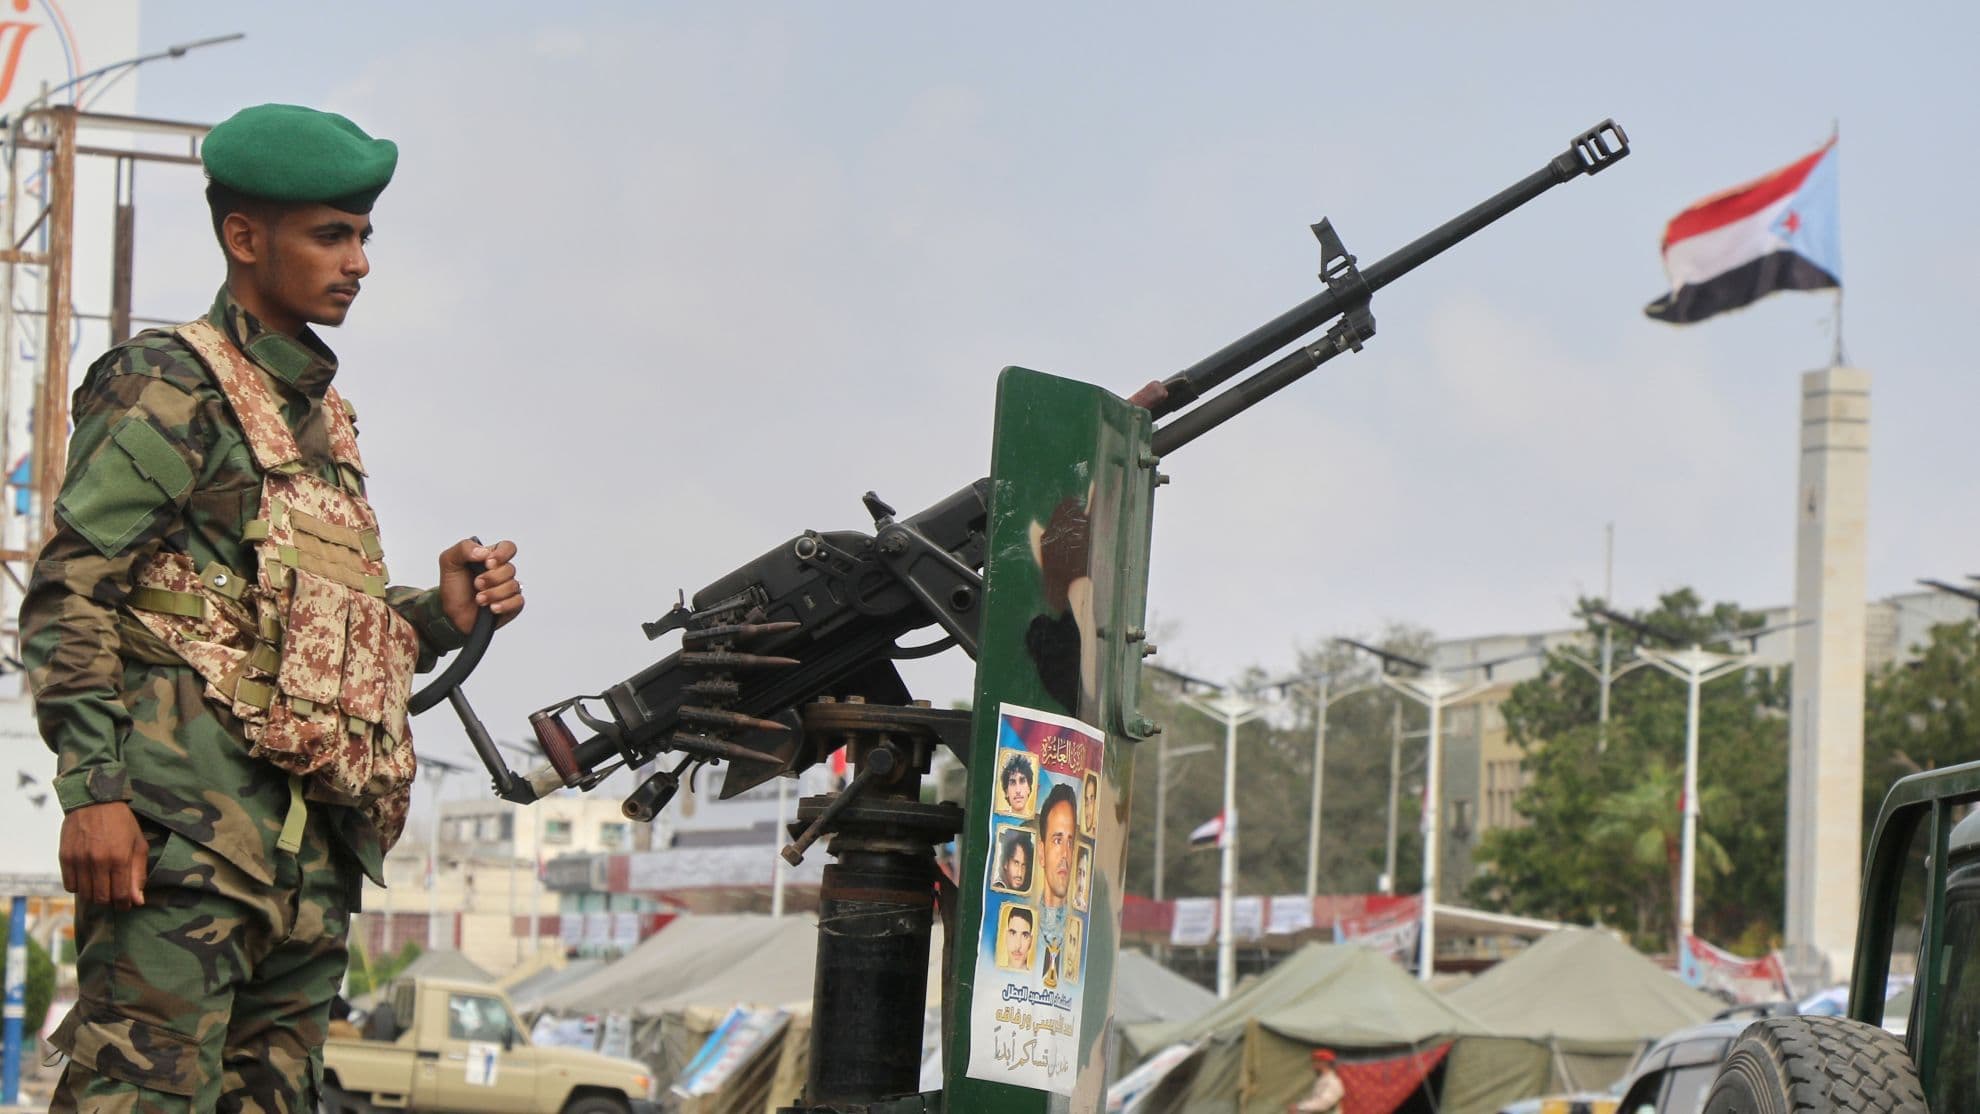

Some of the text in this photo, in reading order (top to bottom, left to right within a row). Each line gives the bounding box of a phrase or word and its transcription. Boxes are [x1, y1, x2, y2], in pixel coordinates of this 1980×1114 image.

[1002, 984, 1029, 1003] البطل
[1029, 988, 1054, 1006] الشهيد
[995, 1007, 1032, 1030] ورفاقه
